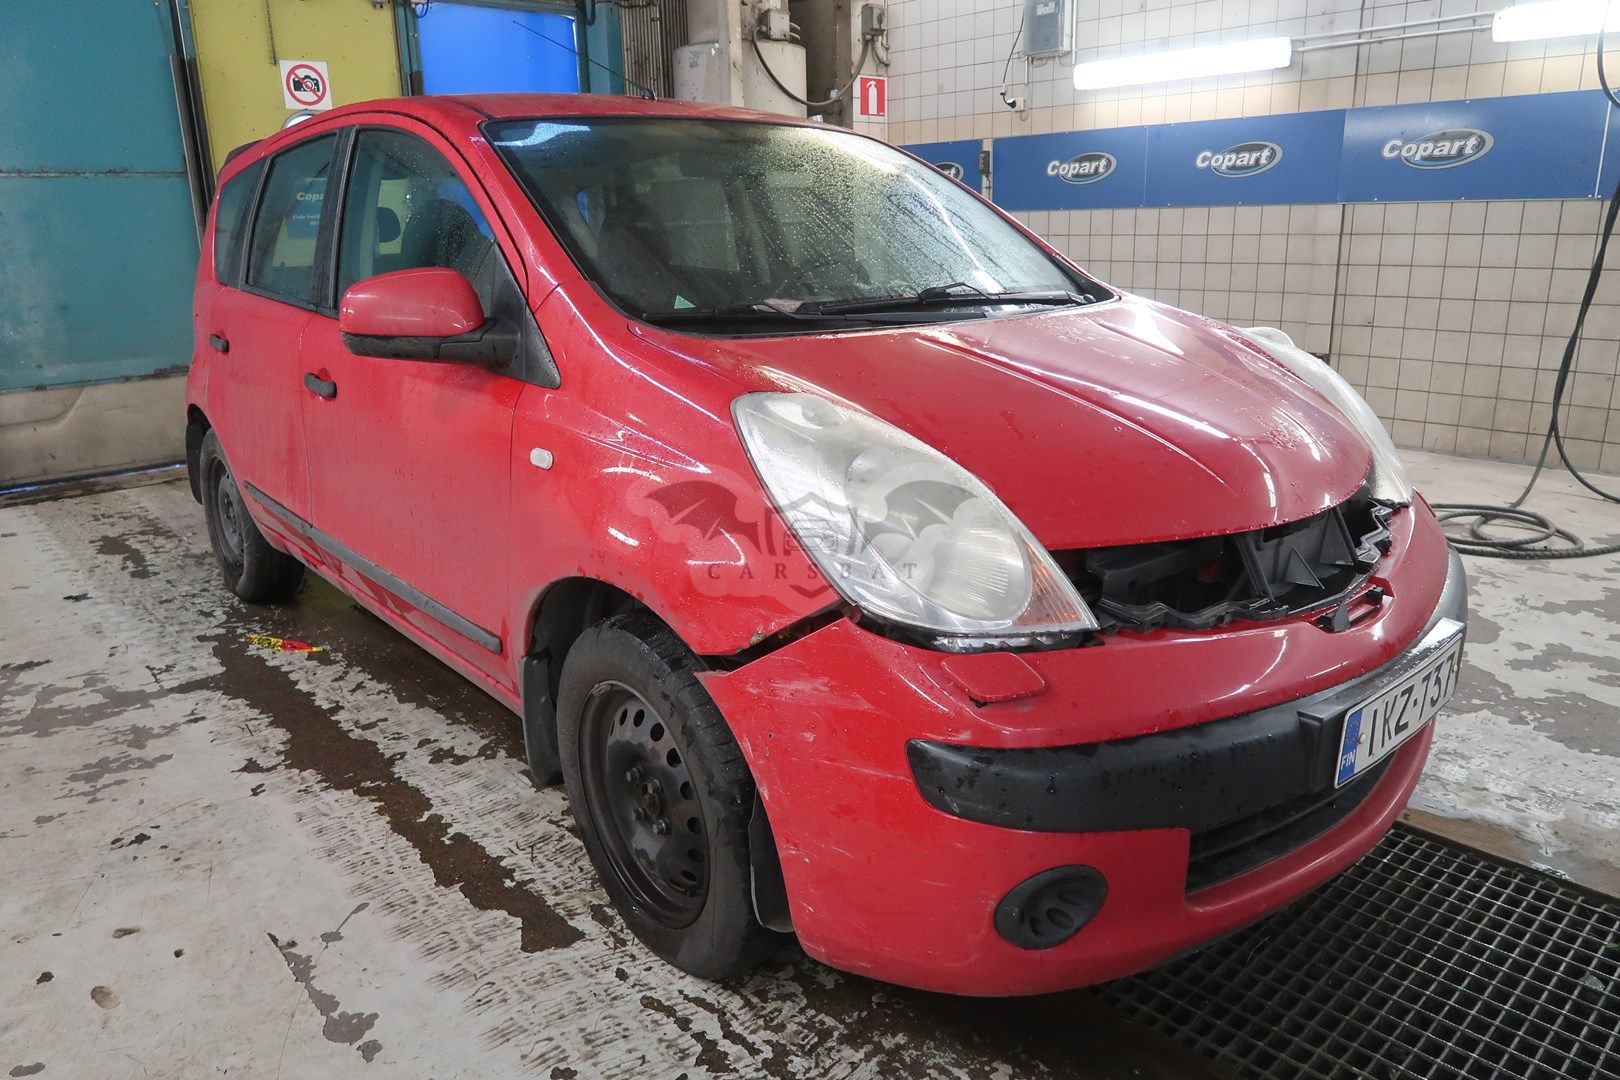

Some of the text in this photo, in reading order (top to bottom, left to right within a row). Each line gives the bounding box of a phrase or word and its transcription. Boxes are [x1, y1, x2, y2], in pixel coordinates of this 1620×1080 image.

[1195, 146, 1271, 170] Copart
[1381, 134, 1480, 161] Copart
[1046, 156, 1108, 178] Copart
[1368, 651, 1457, 757] IKZ-737
[1340, 748, 1357, 771] FIN
